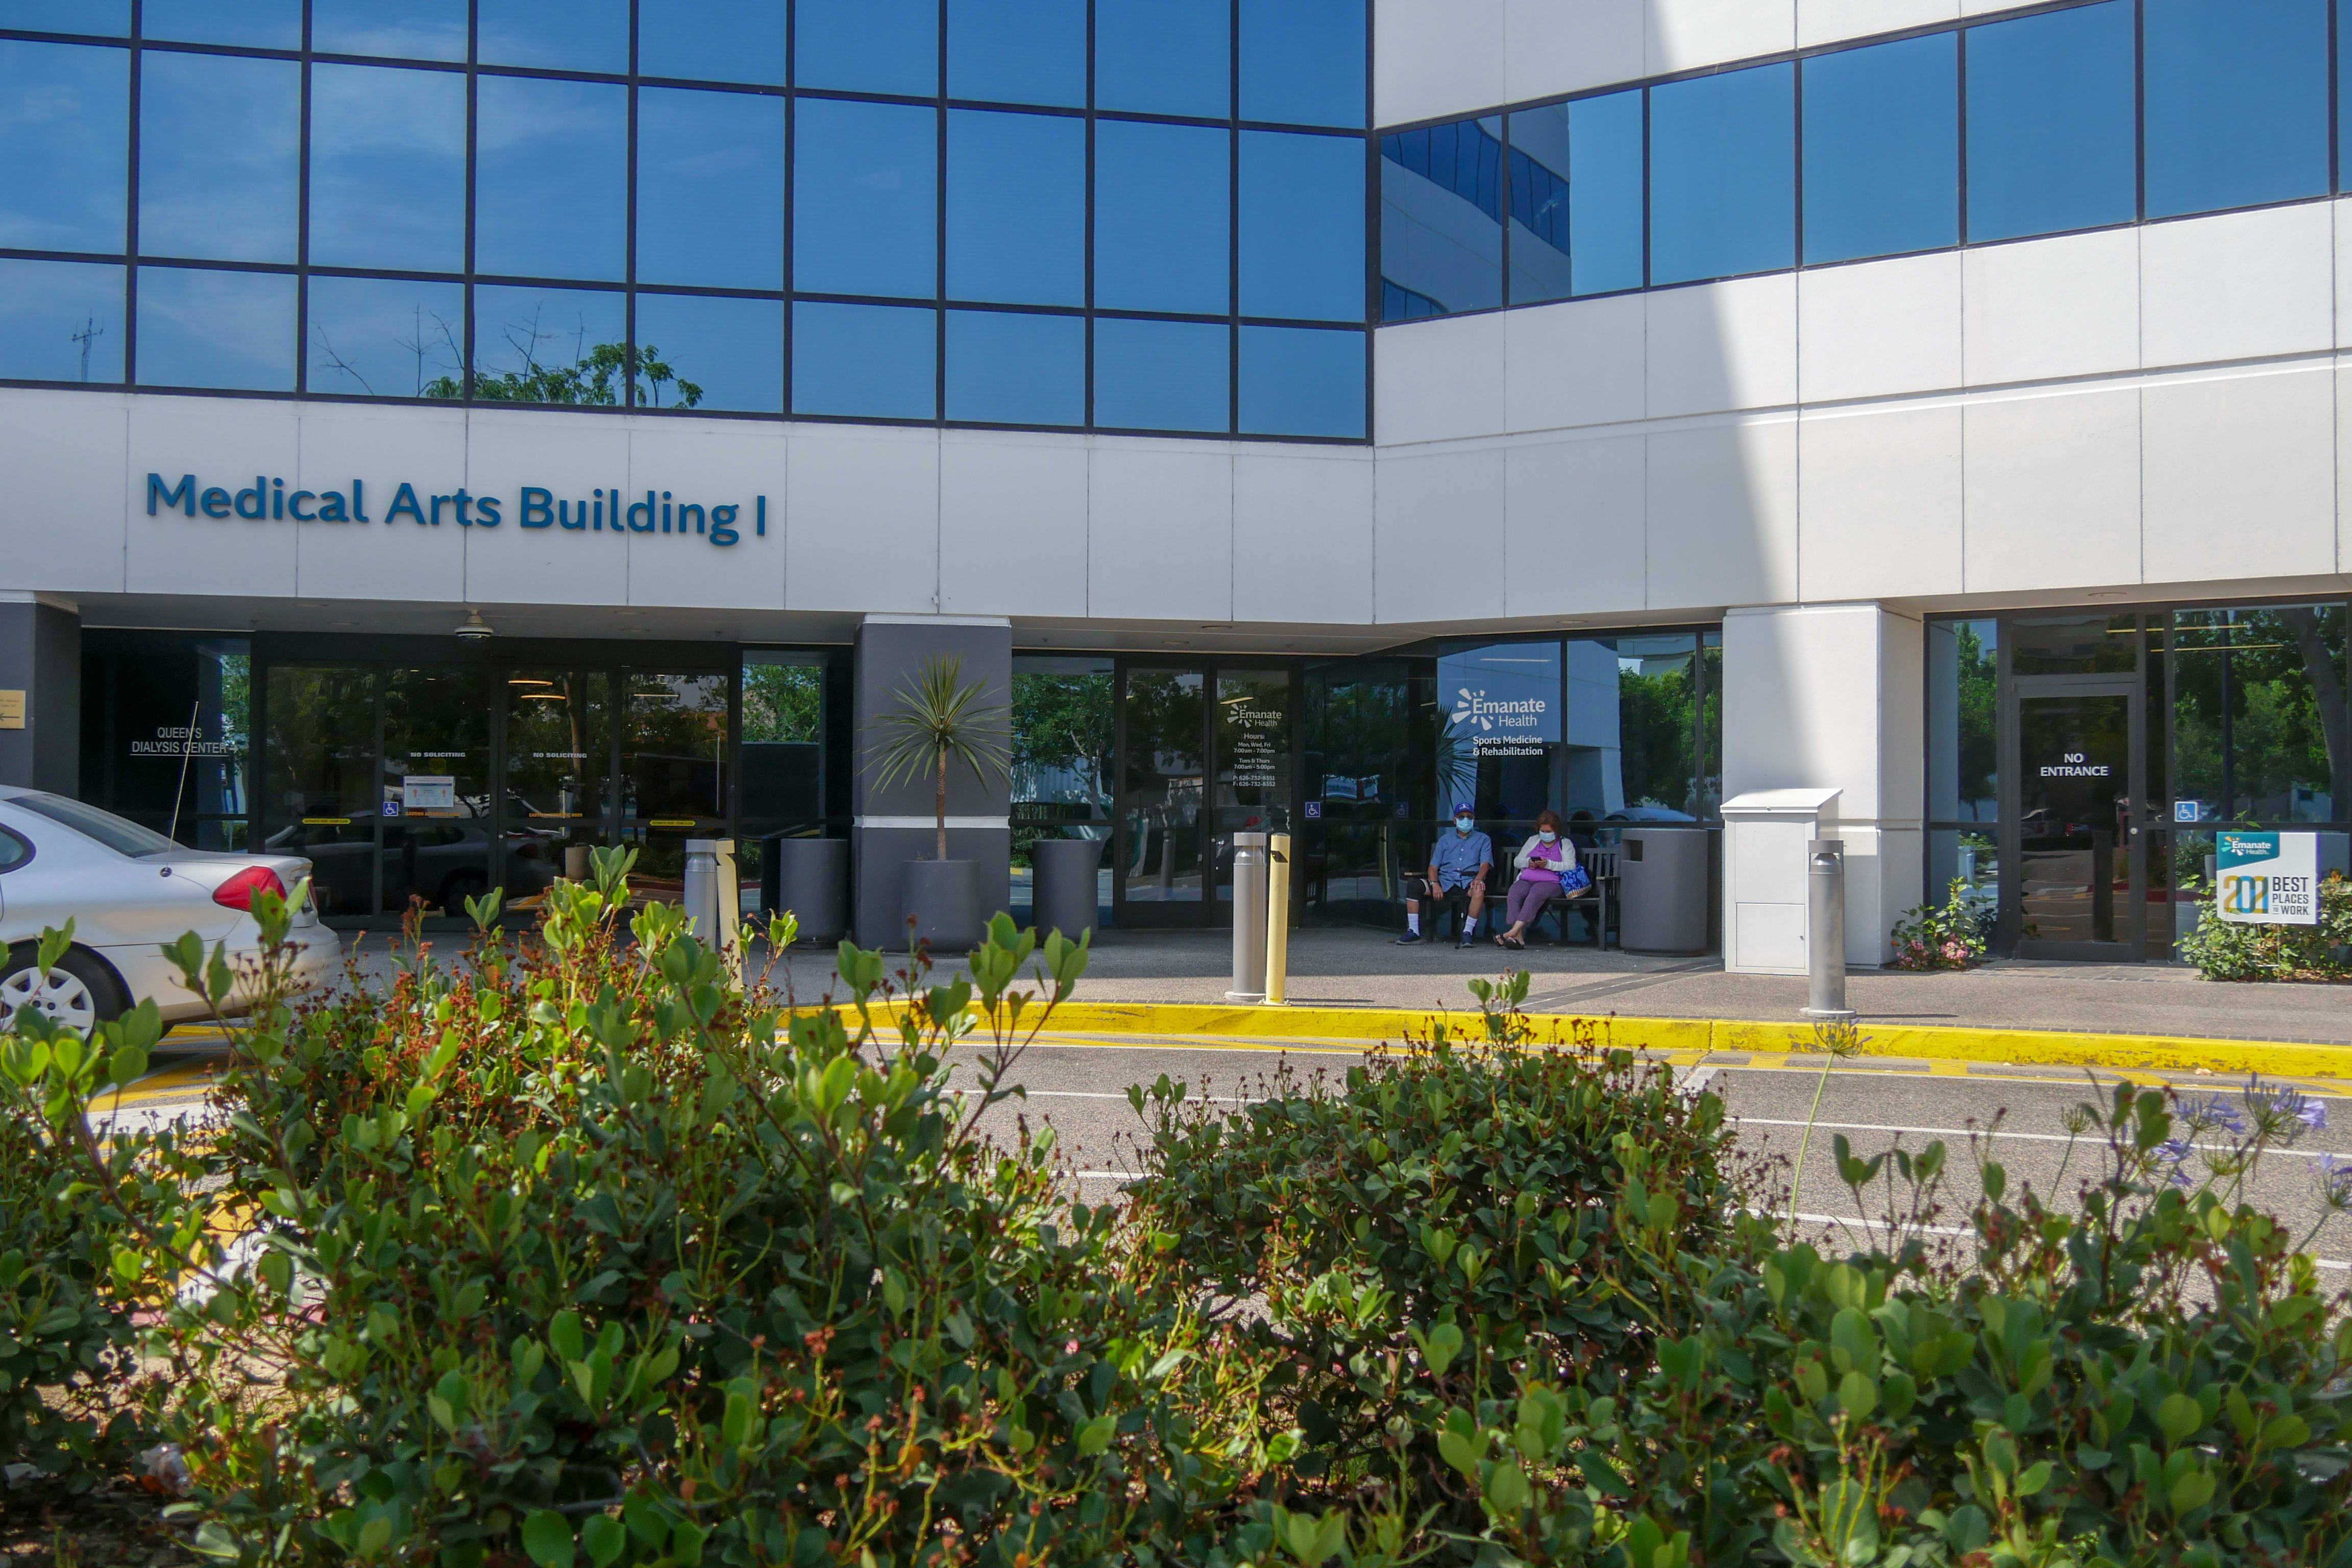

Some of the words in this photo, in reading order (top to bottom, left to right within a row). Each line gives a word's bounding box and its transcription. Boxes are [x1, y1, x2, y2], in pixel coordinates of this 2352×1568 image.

[147, 473, 369, 523] Medical
[384, 482, 502, 528] Arts
[520, 486, 740, 546] Building
[757, 495, 766, 536] I
[1473, 698, 1546, 714] Emanate
[1239, 709, 1282, 719] Emanate
[1499, 715, 1537, 727] Health
[157, 727, 202, 739] QUEEN'S
[1473, 736, 1502, 746] Sports
[1503, 735, 1543, 745] Medicine
[132, 741, 180, 753] DIALYSIS
[183, 742, 227, 754] CENTER
[1473, 748, 1480, 756] &
[1481, 747, 1543, 756] Rehabilitation
[2064, 753, 2084, 764] NO
[2040, 766, 2109, 776] ENTRANCE
[2232, 841, 2271, 849] Emanate
[2272, 876, 2309, 892] BEST
[2223, 875, 2269, 914] 2021
[2272, 894, 2309, 904] PLACES
[2281, 905, 2309, 915] WORK
